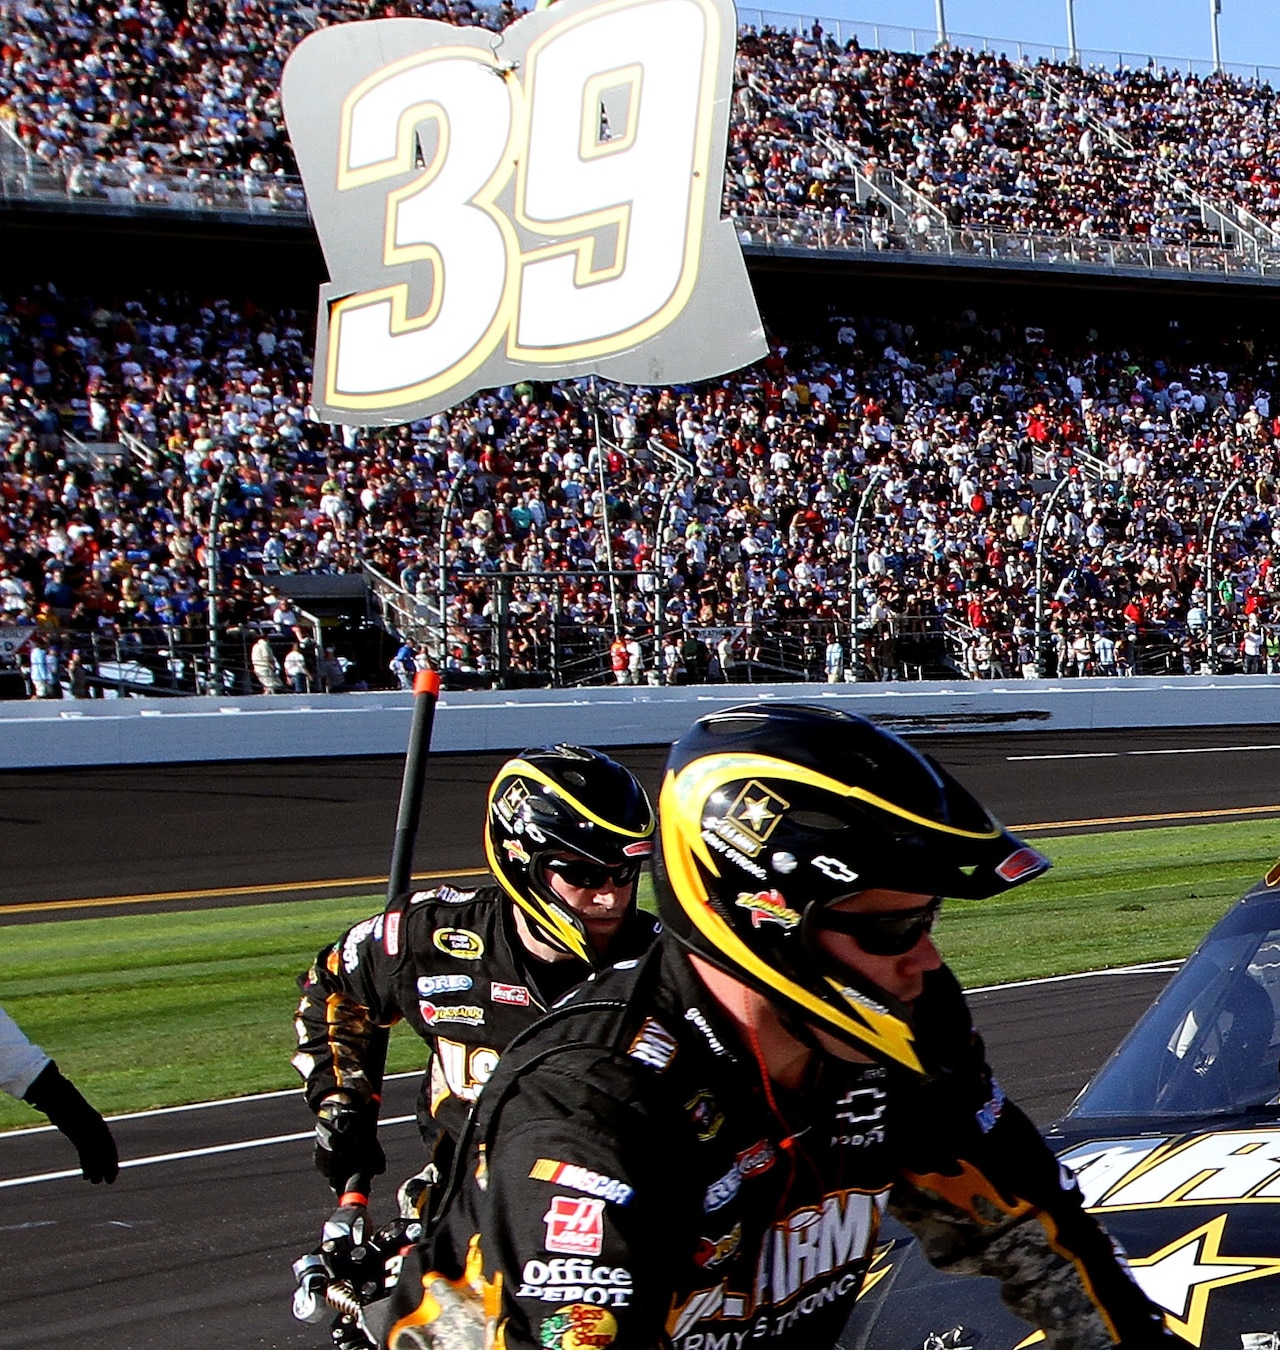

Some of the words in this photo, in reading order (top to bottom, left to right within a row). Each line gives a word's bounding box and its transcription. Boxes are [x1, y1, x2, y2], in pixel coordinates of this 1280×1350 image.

[324, 0, 722, 408] 39
[417, 975, 473, 997] OREO
[556, 1163, 634, 1205] NASCAR
[523, 1257, 632, 1286] Office
[516, 1283, 634, 1307] DEPOT
